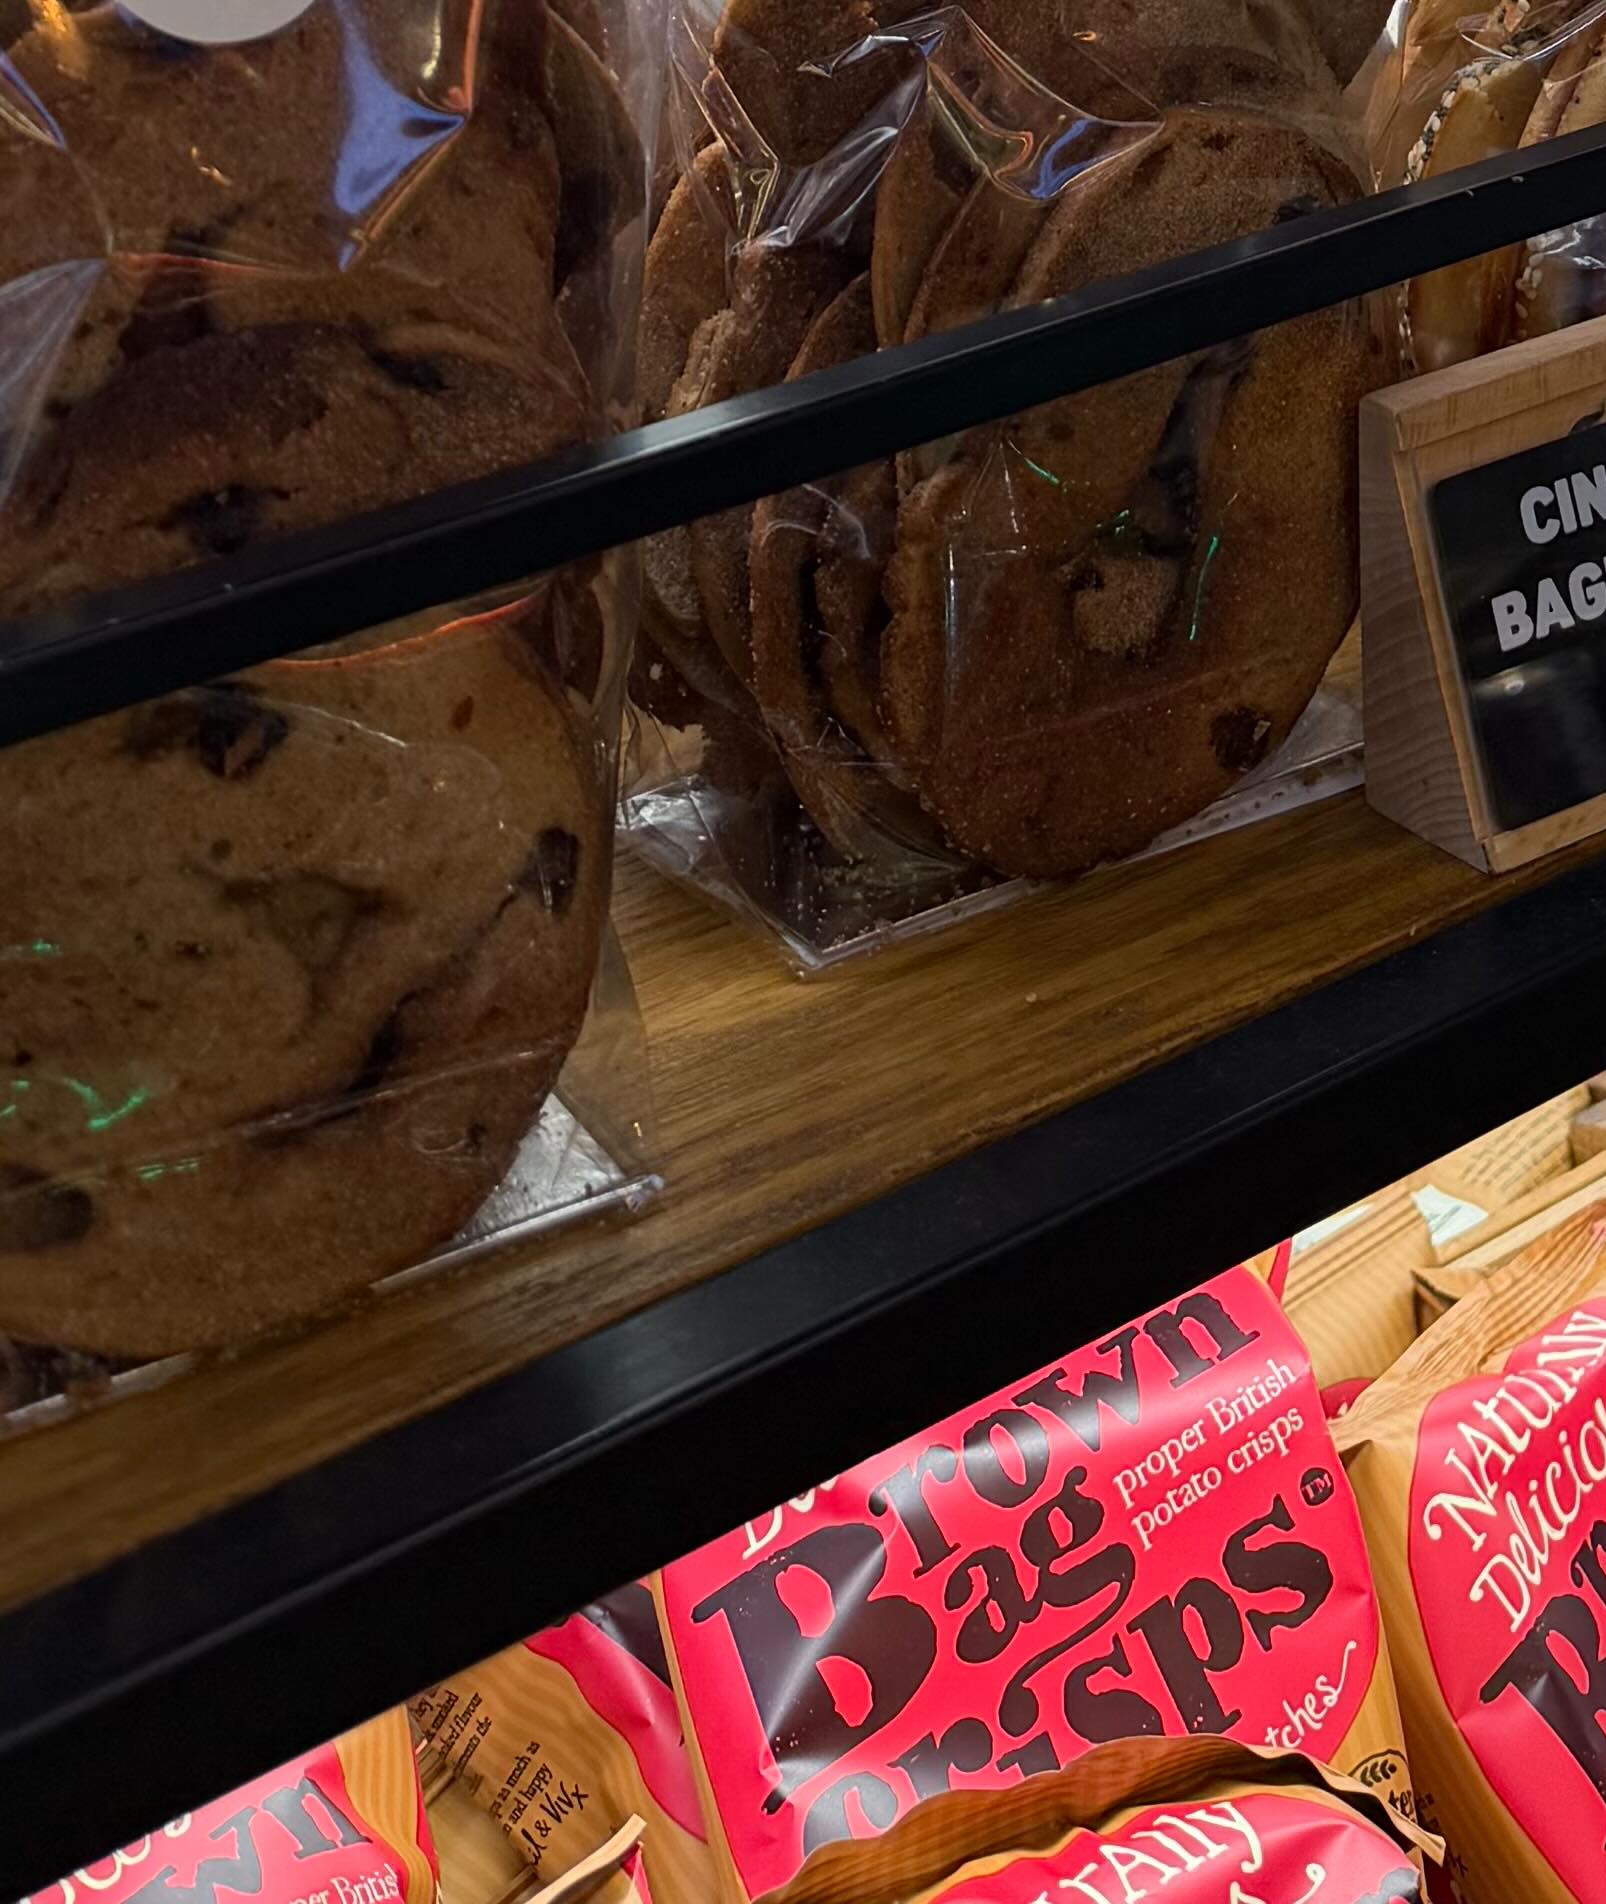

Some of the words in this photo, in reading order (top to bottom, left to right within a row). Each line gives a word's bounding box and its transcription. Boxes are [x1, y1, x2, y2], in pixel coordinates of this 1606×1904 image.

[1112, 1425, 1210, 1509] proper
[1207, 1360, 1298, 1437] British
[1132, 1462, 1226, 1550] potato
[1225, 1404, 1304, 1478] crisps
[692, 1290, 1262, 1815] Brown
[692, 1466, 1136, 1815] Bag
[1263, 1641, 1358, 1754] tches
[507, 1755, 531, 1788] much
[508, 1797, 527, 1824] and
[523, 1763, 553, 1802] happy
